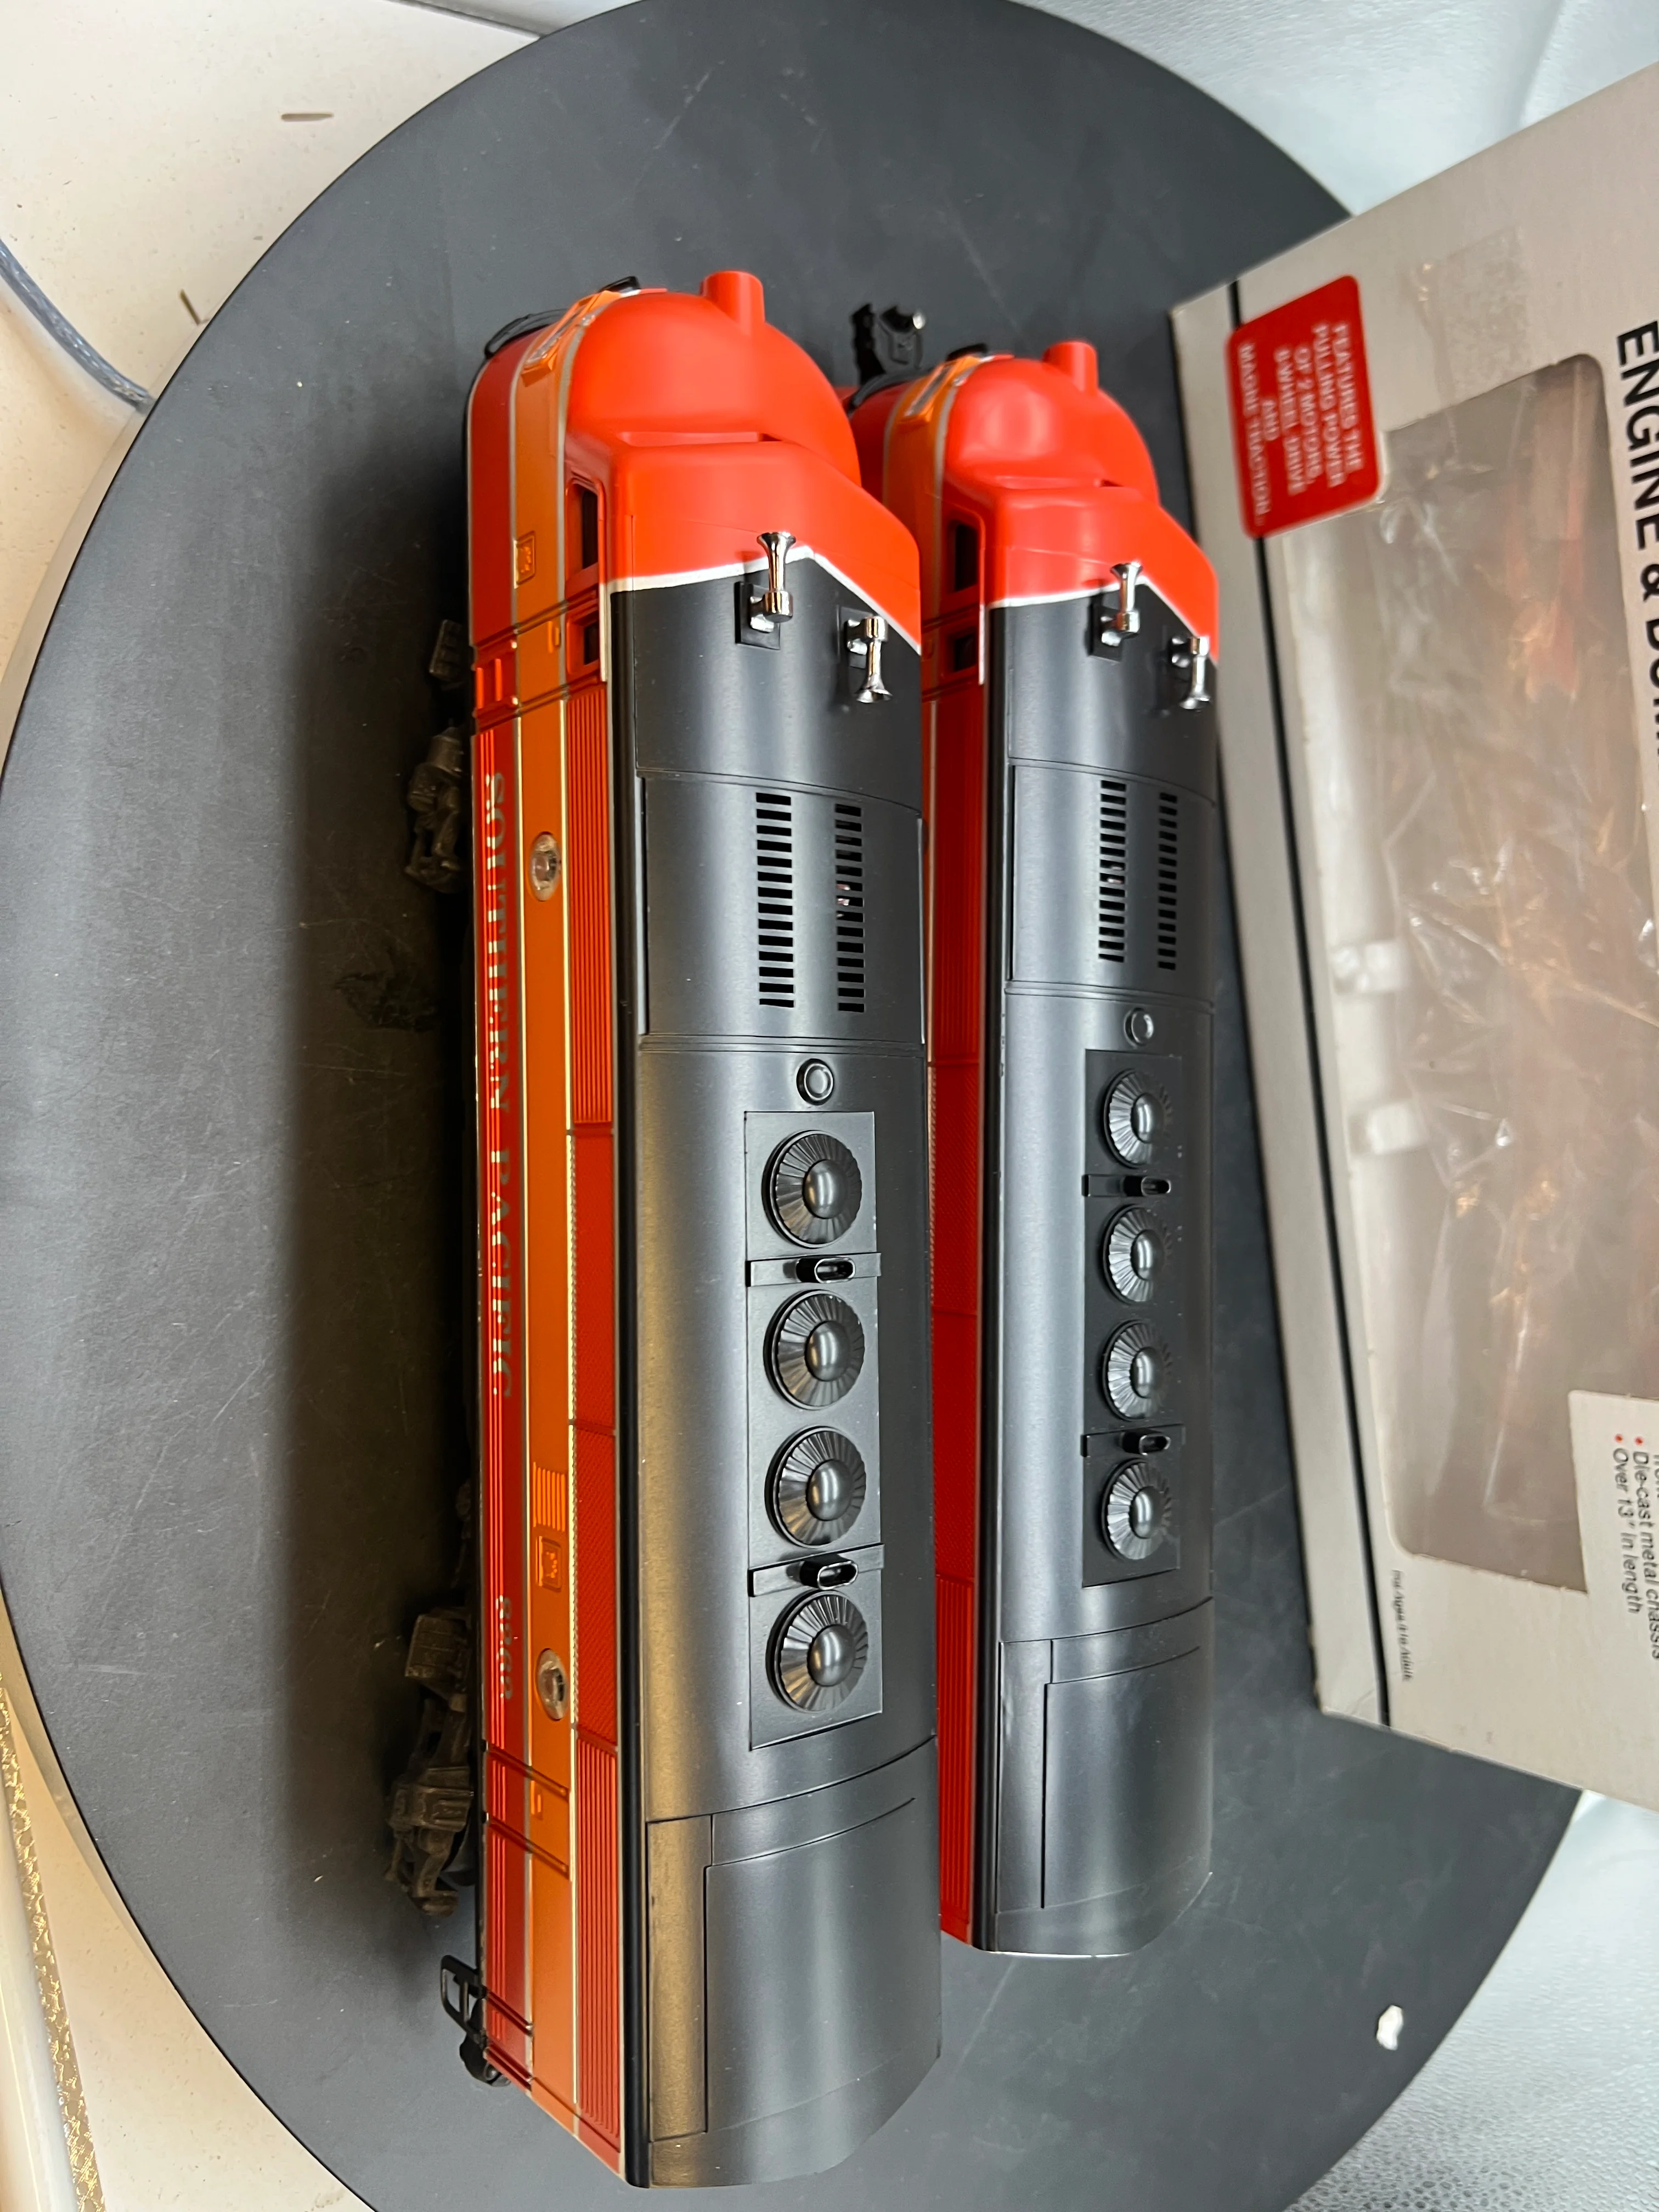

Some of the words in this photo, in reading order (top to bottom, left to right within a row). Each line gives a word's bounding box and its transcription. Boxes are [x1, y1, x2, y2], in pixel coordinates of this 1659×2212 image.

[1294, 346, 1312, 373] OF
[1313, 323, 1335, 410] PULLING
[1333, 321, 1357, 430] FEATURES
[1261, 398, 1279, 441] AND
[1617, 320, 1659, 550] ENGINE
[1283, 436, 1306, 495] DRIVE
[1323, 412, 1345, 488] POWER
[1344, 430, 1364, 474] THE
[485, 772, 509, 1114] SOUTHERN
[492, 1148, 512, 1398] PACIFIC
[1612, 1447, 1631, 1492] Over
[1632, 1451, 1654, 1528] Die-cast
[1617, 1498, 1635, 1528] 13"
[1620, 1532, 1638, 1549] in
[1621, 1554, 1643, 1614] length
[1640, 1531, 1659, 1585] metal
